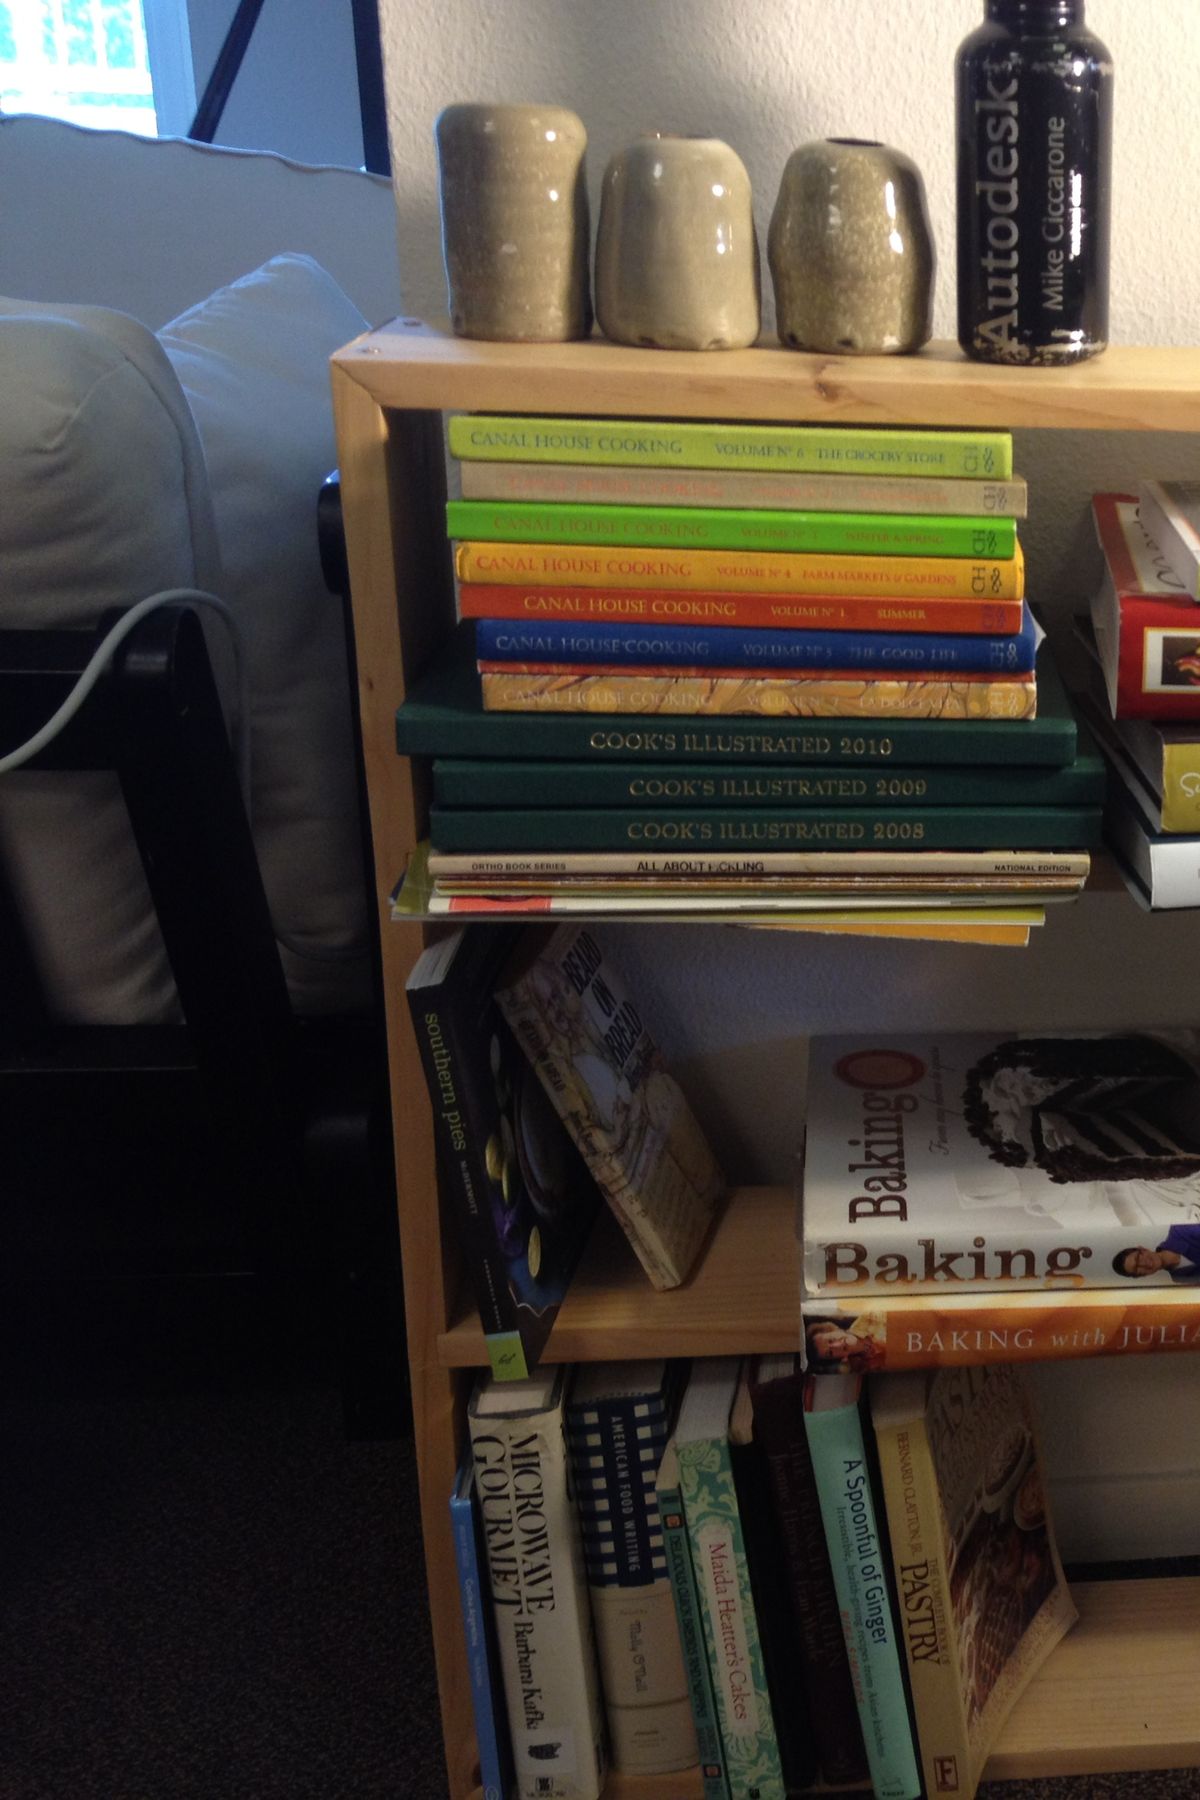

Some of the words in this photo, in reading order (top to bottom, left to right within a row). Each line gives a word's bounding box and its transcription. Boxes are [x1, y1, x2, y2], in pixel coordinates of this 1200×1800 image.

[1041, 115, 1065, 243] Ciccarone
[974, 77, 1020, 352] Autodesk
[1041, 248, 1064, 311] Mike
[470, 431, 528, 448] CANAL
[534, 433, 592, 451] HOUSE
[598, 436, 682, 455] COOKING
[715, 442, 773, 459] VOLUME
[815, 448, 841, 460] THE
[844, 448, 902, 463] GROCERY
[905, 450, 947, 465] STORE
[493, 516, 551, 532] CANAL
[559, 519, 616, 536] HOUSE
[623, 520, 709, 539] COOKING
[475, 556, 536, 572] CANAL
[543, 557, 601, 574] HOUSE
[606, 559, 692, 577] COOKING
[716, 566, 766, 578] VOLUME
[802, 569, 835, 581] FARM
[837, 571, 893, 583] MARKETS
[903, 572, 957, 585] GARDENS
[523, 596, 583, 612] CANAL
[589, 597, 647, 613] HOUSE
[651, 599, 737, 617] COOKING
[770, 606, 820, 617] VOLUME
[877, 608, 926, 620] SUMMER
[496, 635, 554, 651] CANAL
[561, 637, 620, 653] HOUSE
[624, 639, 709, 656] COOKING
[743, 643, 801, 657] VOLUME
[881, 646, 925, 661] GOOD
[930, 646, 958, 661] LIFE
[503, 690, 562, 704] CANAL
[568, 691, 625, 706] HOUSE
[630, 692, 714, 707] COOKING
[589, 731, 677, 752] COOK'S
[683, 734, 832, 755] ILLUSTRATED
[839, 737, 893, 756] 2010
[628, 778, 716, 797] COOK'S
[722, 779, 868, 797] ILLUSTRATED
[875, 779, 928, 797] 2009
[627, 822, 713, 840] COOK'S
[719, 823, 865, 840] ILLUSTRATED
[873, 823, 925, 840] 2008
[471, 862, 503, 872] ORTHO
[505, 862, 532, 872] BOOK
[534, 862, 567, 872] SERIES
[637, 861, 660, 872] ALL
[663, 861, 705, 872] ABOUT
[994, 864, 1037, 873] NATIONAL
[1038, 864, 1072, 873] EDITION
[561, 930, 604, 997] BEARD
[591, 974, 619, 1019] ON
[603, 1001, 645, 1067] BREAD
[424, 1013, 458, 1117] southern
[442, 1111, 467, 1153] pies
[847, 1091, 919, 1224] Baking
[458, 1159, 478, 1215] McDERMOTT
[816, 1235, 1094, 1290] Baking
[906, 1328, 1036, 1353] BAKING
[1049, 1327, 1106, 1348] with
[609, 1415, 629, 1479] AMERICAN
[842, 1458, 862, 1474] A
[896, 1431, 914, 1486] BERNARD
[471, 1433, 525, 1617] GOURMET
[508, 1432, 555, 1616] MICROWAVE
[618, 1484, 633, 1515] FOOD
[844, 1475, 876, 1562] Spoonful
[624, 1519, 640, 1572] WRITING
[708, 1541, 729, 1594] Maida
[861, 1563, 879, 1582] of
[717, 1597, 744, 1667] Heatter's
[865, 1586, 888, 1646] Ginger
[899, 1560, 941, 1666] PASTRY
[512, 1621, 536, 1684] Barbara
[727, 1668, 749, 1721] Cakes
